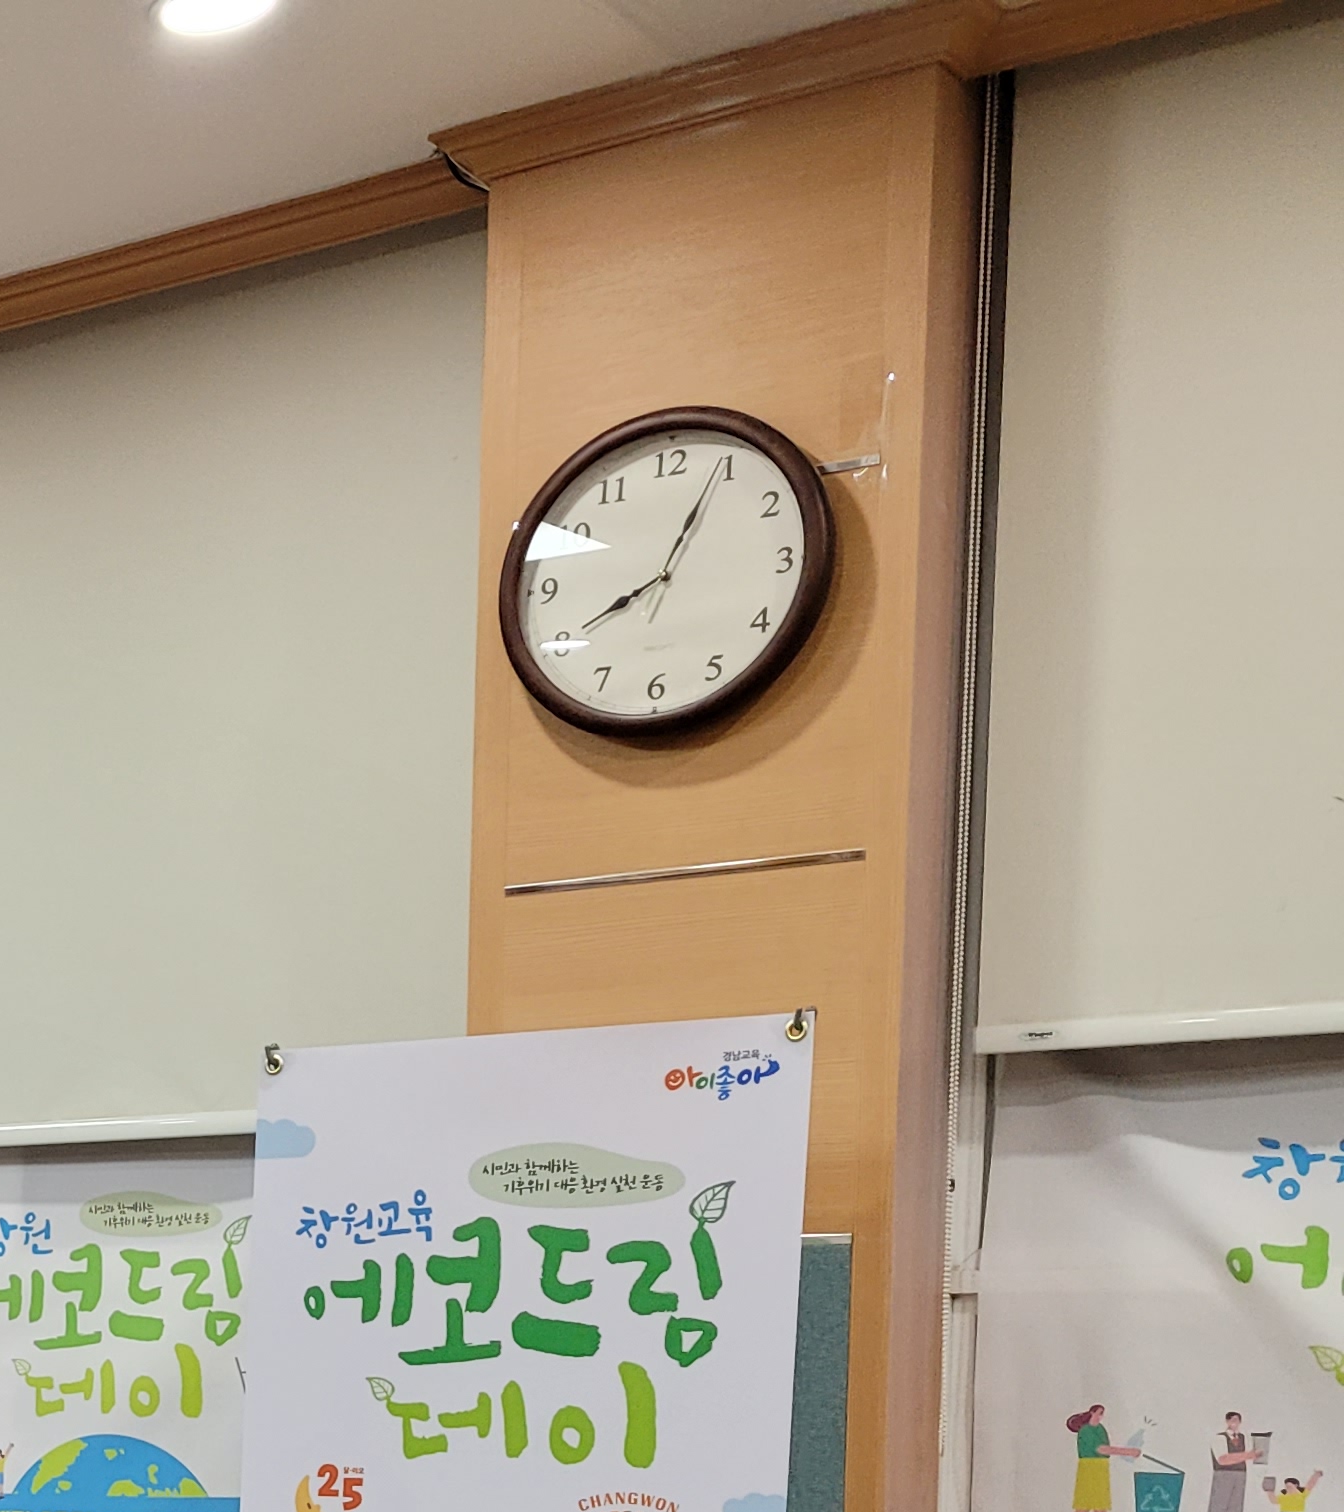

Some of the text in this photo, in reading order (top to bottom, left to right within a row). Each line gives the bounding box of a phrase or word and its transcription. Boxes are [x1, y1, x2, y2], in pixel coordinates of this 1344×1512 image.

[654, 449, 687, 478] 12
[723, 454, 735, 481] 1
[598, 477, 626, 505] 11
[760, 491, 780, 518] 2
[559, 522, 591, 549] 10
[776, 547, 794, 574] 3
[540, 578, 558, 604] 9
[750, 607, 770, 633] 4
[554, 631, 570, 657] 8
[593, 667, 612, 692] 7
[705, 655, 724, 681] 5
[647, 673, 666, 700] 6
[723, 1050, 760, 1061] 경남교육
[665, 1059, 780, 1101] 아이좋아
[525, 1158, 579, 1176] 함께하는
[1243, 1137, 1344, 1200] 창
[503, 1174, 664, 1195] 기후위기 대응 환경 실천 운동
[194, 1213, 210, 1225] 운동
[295, 1190, 433, 1249] 창원교육
[304, 1215, 723, 1366] 에코드림
[26, 1343, 203, 1418] 데이
[387, 1362, 655, 1469] 데이
[317, 1464, 363, 1511] 25
